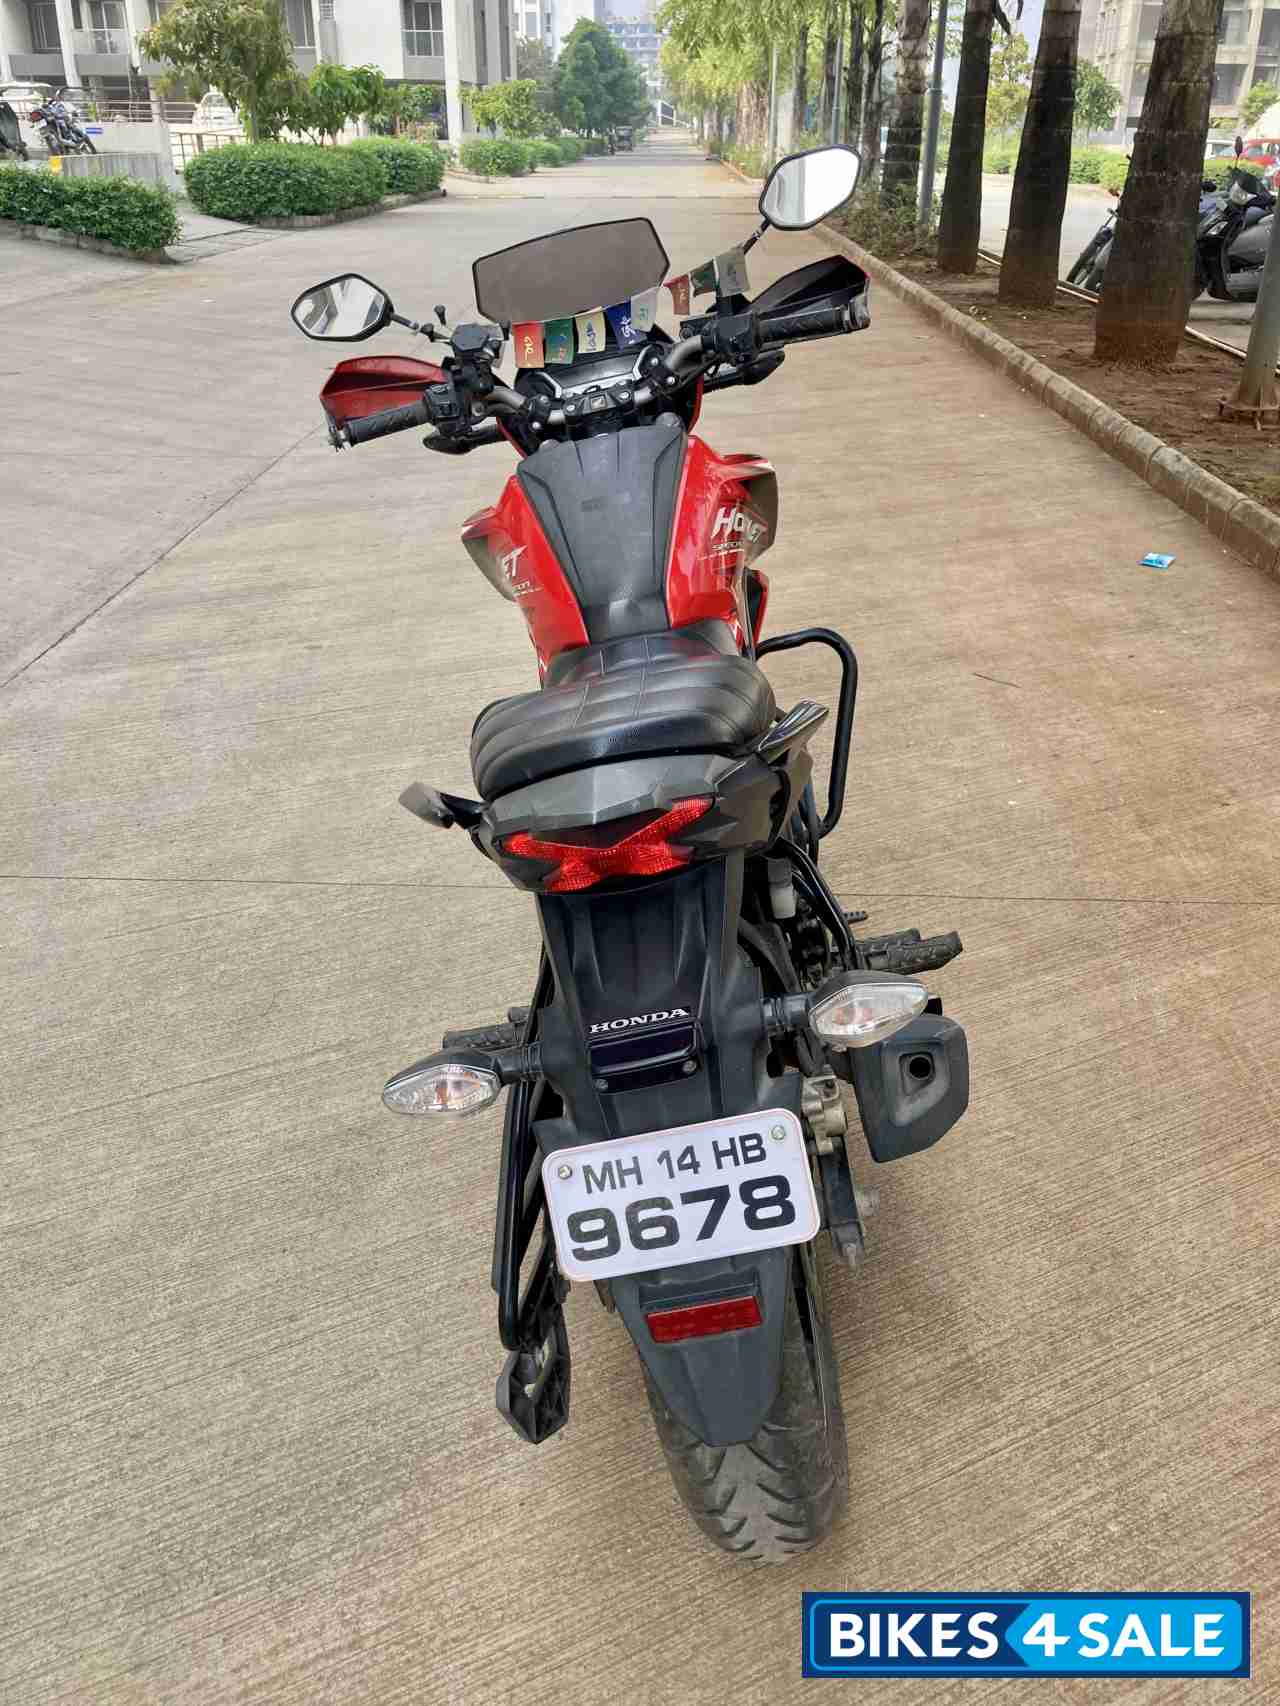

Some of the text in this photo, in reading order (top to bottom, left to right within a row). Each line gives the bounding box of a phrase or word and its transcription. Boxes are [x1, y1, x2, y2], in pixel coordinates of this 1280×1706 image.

[589, 1006, 690, 1034] HONDA
[581, 1132, 767, 1195] MH 14 HB
[566, 1174, 796, 1262] 9678
